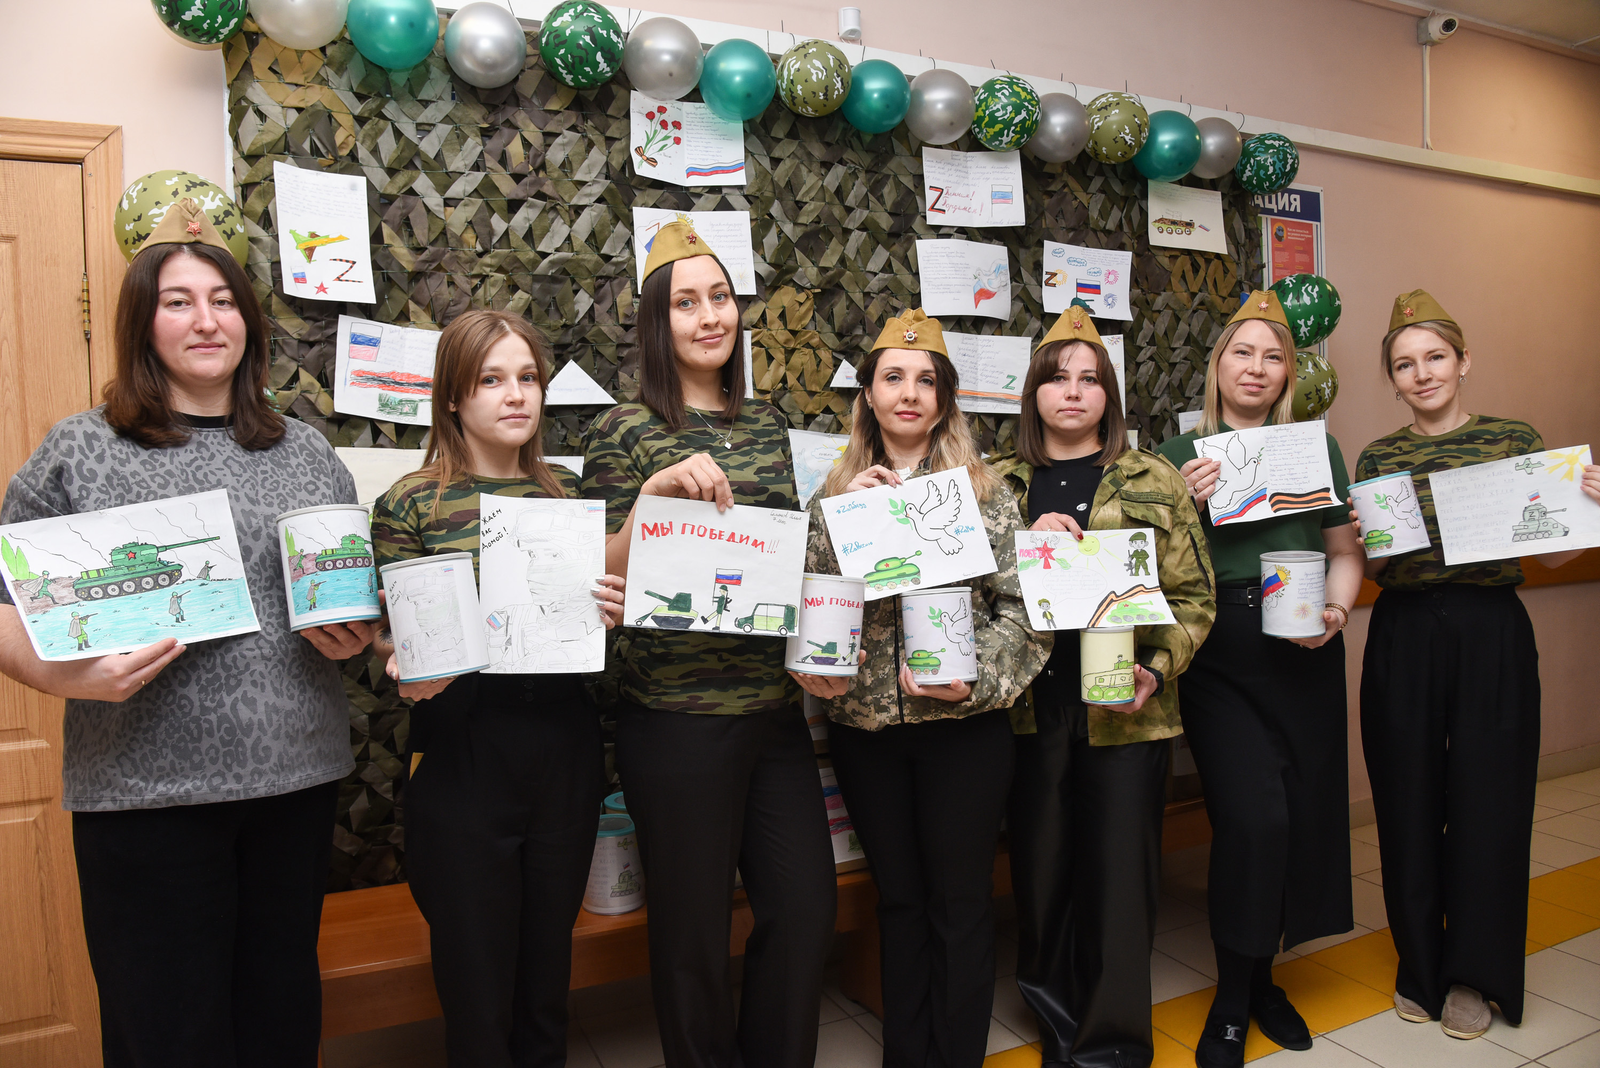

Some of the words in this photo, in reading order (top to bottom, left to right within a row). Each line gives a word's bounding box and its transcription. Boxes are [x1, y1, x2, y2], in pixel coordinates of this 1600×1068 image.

[928, 185, 946, 214] Z
[329, 258, 363, 283] Z
[1044, 271, 1058, 287] Z
[1002, 374, 1018, 390] Z
[641, 521, 673, 541] МЫ
[681, 523, 780, 554] ПОБЕДИМ!!!
[804, 596, 825, 610] МЫ
